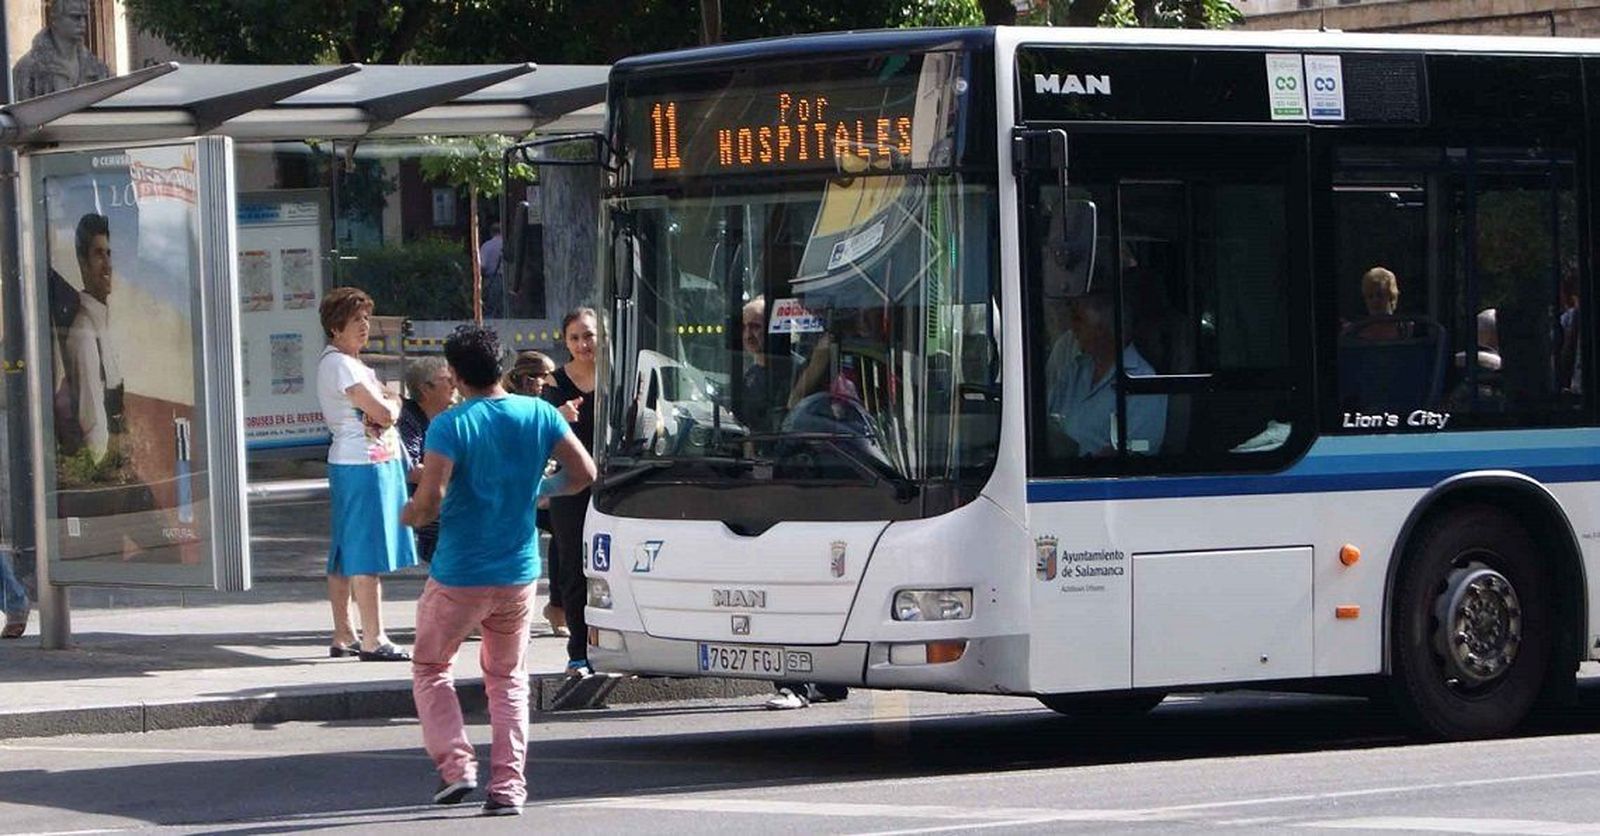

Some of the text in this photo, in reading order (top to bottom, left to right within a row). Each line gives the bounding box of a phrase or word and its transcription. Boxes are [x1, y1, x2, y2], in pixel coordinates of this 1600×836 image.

[1034, 73, 1111, 95] MAN
[779, 92, 829, 123] Por
[651, 102, 681, 169] 11
[718, 117, 913, 166] HOSPITALES
[1342, 409, 1451, 430] Lion's City
[1062, 550, 1125, 564] Ayuntamiento
[1061, 565, 1125, 578] de Salamanca
[711, 589, 767, 609] MAN
[710, 647, 782, 673] 7627 FGJ
[788, 653, 811, 670] SP
